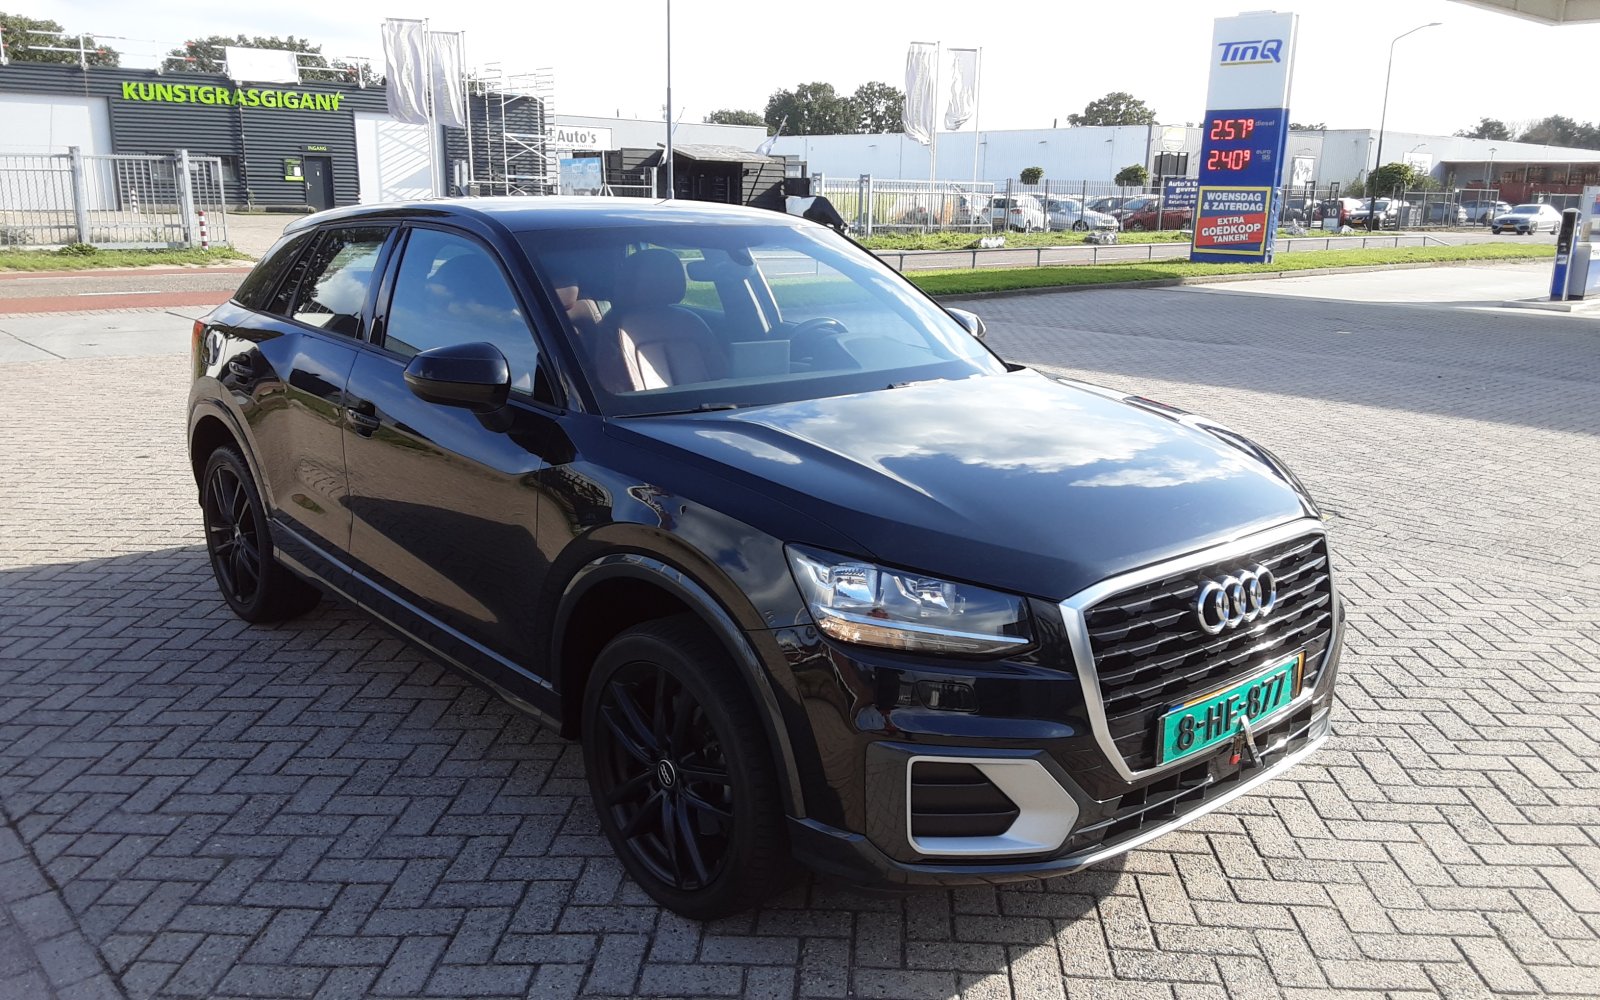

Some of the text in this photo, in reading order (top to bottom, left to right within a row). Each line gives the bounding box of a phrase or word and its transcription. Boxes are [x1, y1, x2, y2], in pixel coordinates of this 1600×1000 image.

[122, 81, 344, 111] KUNSTGRASGIGANT
[557, 129, 597, 144] Auto's
[1207, 192, 1262, 202] WOENSDAG
[1203, 202, 1263, 211] & ZATERDAG
[1327, 208, 1337, 216] 10
[1217, 217, 1245, 225] EXTRA
[1202, 223, 1261, 236] GOEDKOOP
[1213, 234, 1249, 243] TANKEN!
[1177, 670, 1287, 750] 8-HF-877
